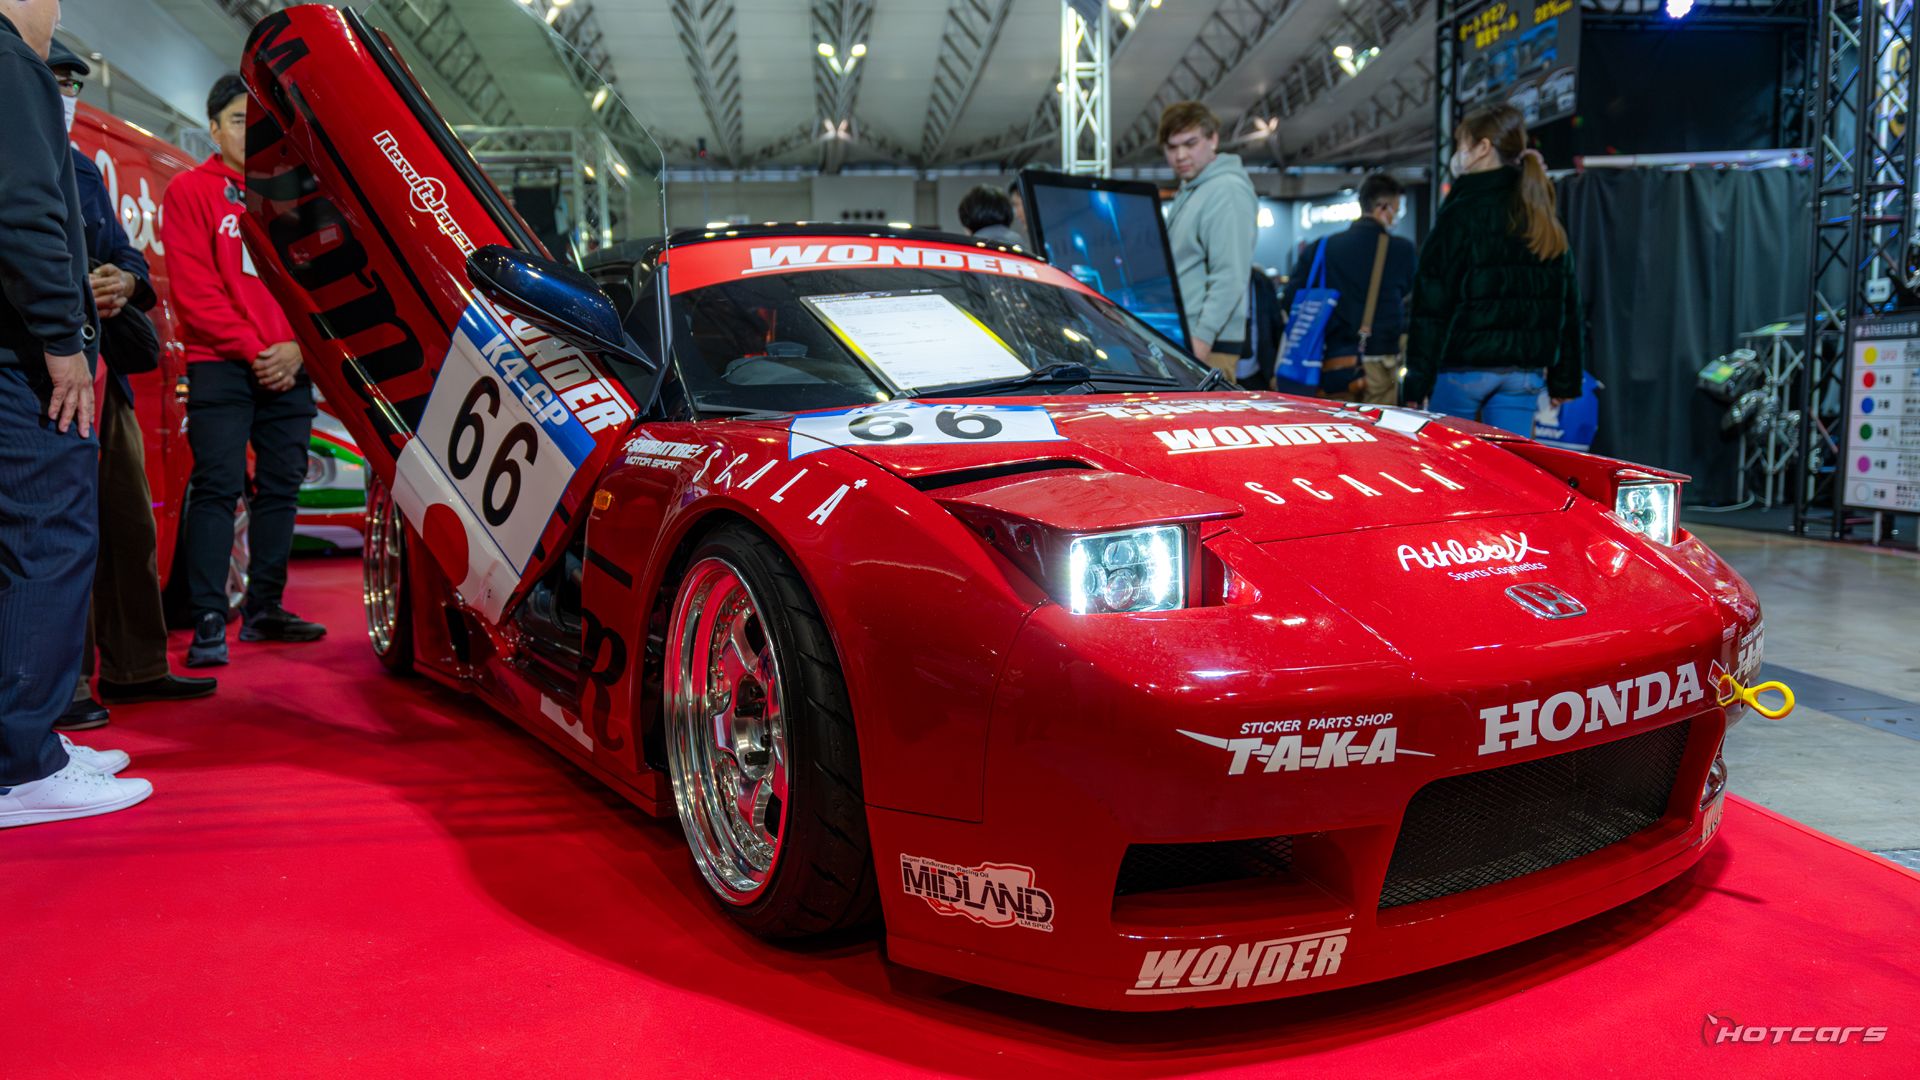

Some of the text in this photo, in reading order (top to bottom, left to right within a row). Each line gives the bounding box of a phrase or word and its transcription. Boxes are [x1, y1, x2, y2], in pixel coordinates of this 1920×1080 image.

[741, 244, 1038, 279] WONDER
[472, 288, 634, 434] ONDER
[481, 333, 570, 426] K4-GP
[848, 410, 1003, 441] 66
[1152, 423, 1378, 455] WONDER
[448, 375, 538, 527] 66
[624, 455, 682, 470] MOTOR SPORT
[1447, 560, 1548, 582] Sports Cosmetics
[1239, 712, 1393, 735] STICKER PARTS SHOP
[1478, 661, 1704, 756] HONDA
[901, 855, 920, 863] Super
[921, 858, 955, 871] Endurance
[956, 866, 979, 877] Racing
[1031, 922, 1051, 931] SPEC
[1125, 927, 1352, 995] WONDER
